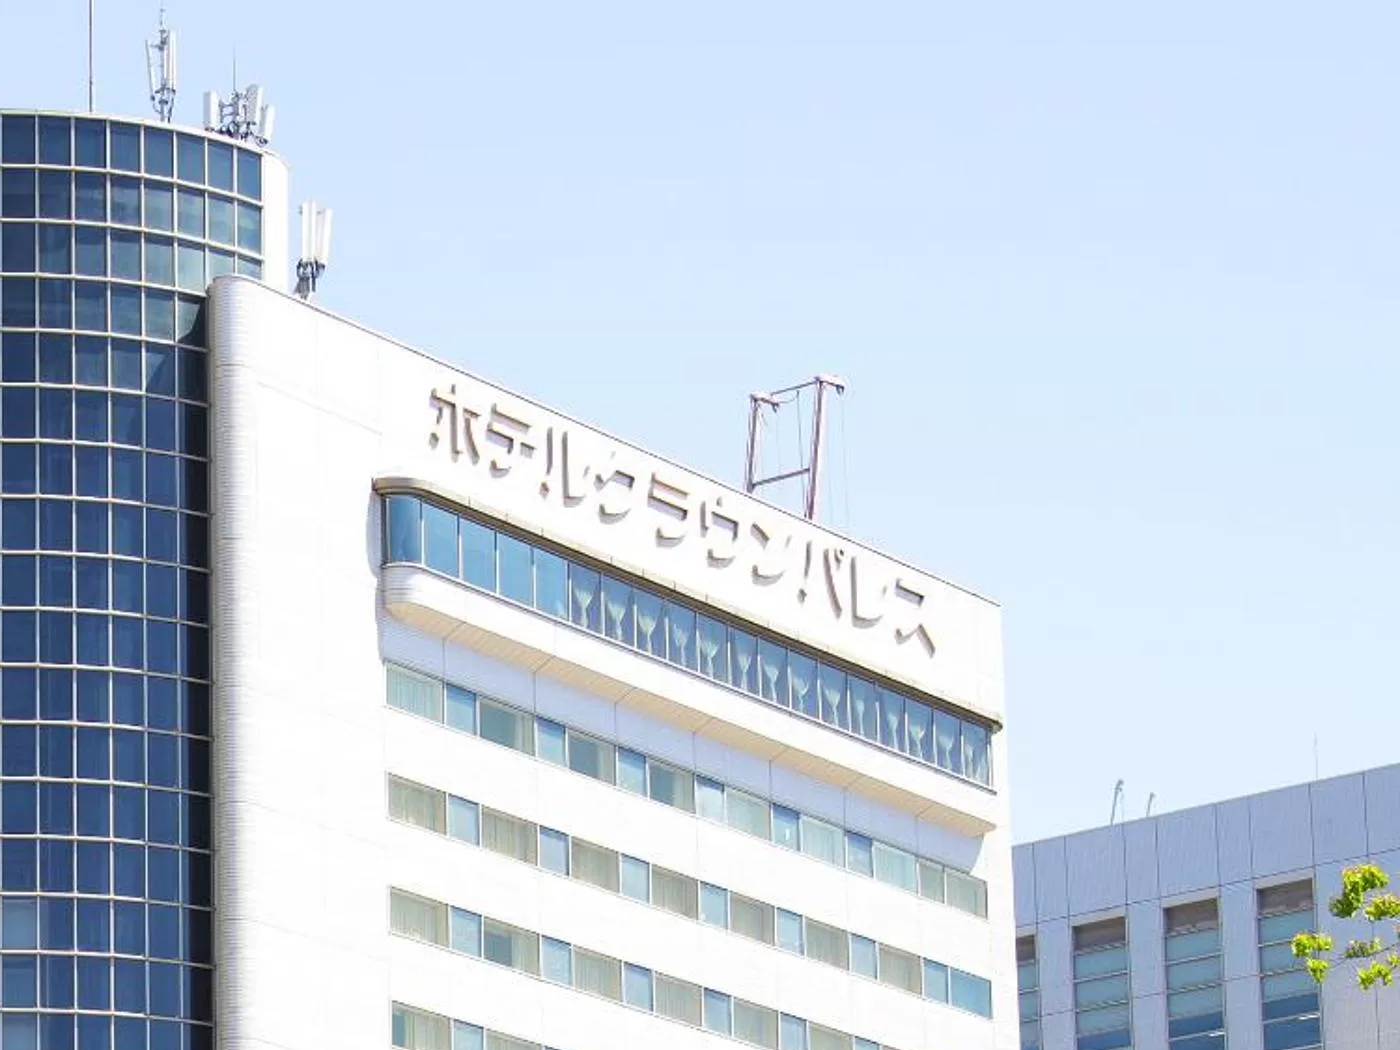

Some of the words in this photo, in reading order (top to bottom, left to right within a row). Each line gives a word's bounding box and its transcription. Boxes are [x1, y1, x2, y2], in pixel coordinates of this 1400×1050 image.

[428, 383, 937, 659] ホテルクラウンパレス
